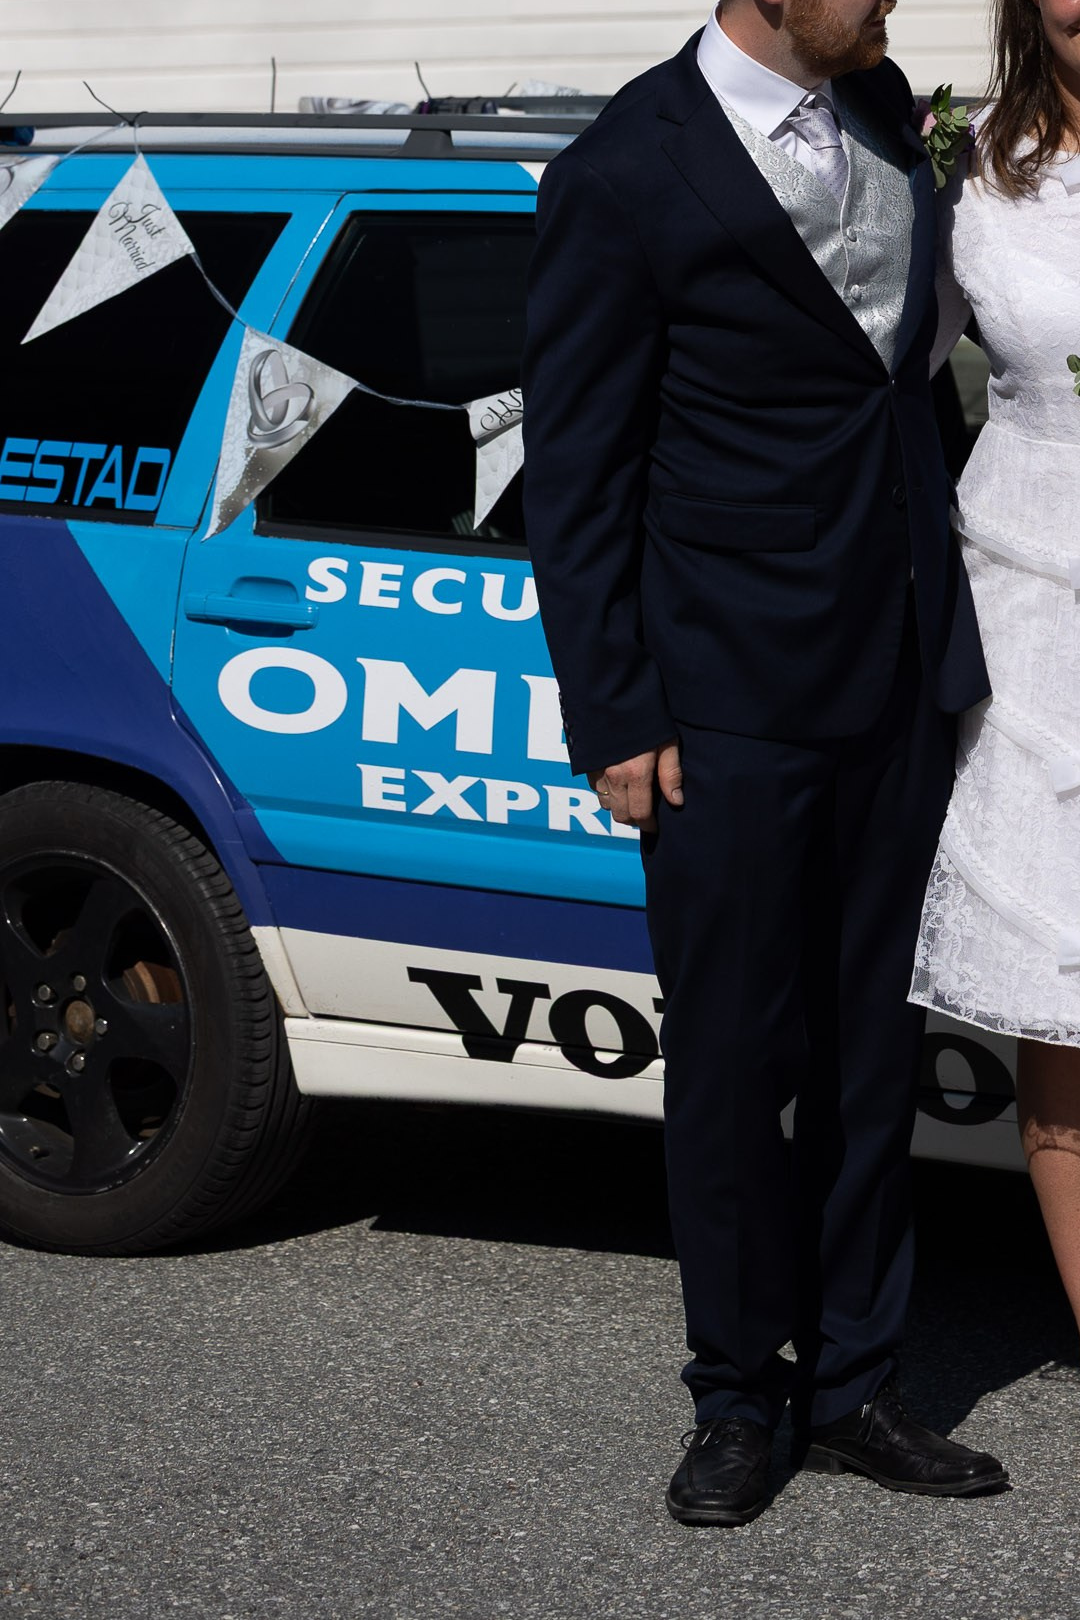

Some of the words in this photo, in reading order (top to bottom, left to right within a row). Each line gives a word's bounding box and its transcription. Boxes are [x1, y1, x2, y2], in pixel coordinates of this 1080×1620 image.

[108, 201, 156, 273] Married
[123, 203, 166, 240] Just
[0, 436, 171, 512] ESTAD
[305, 556, 540, 622] SECU
